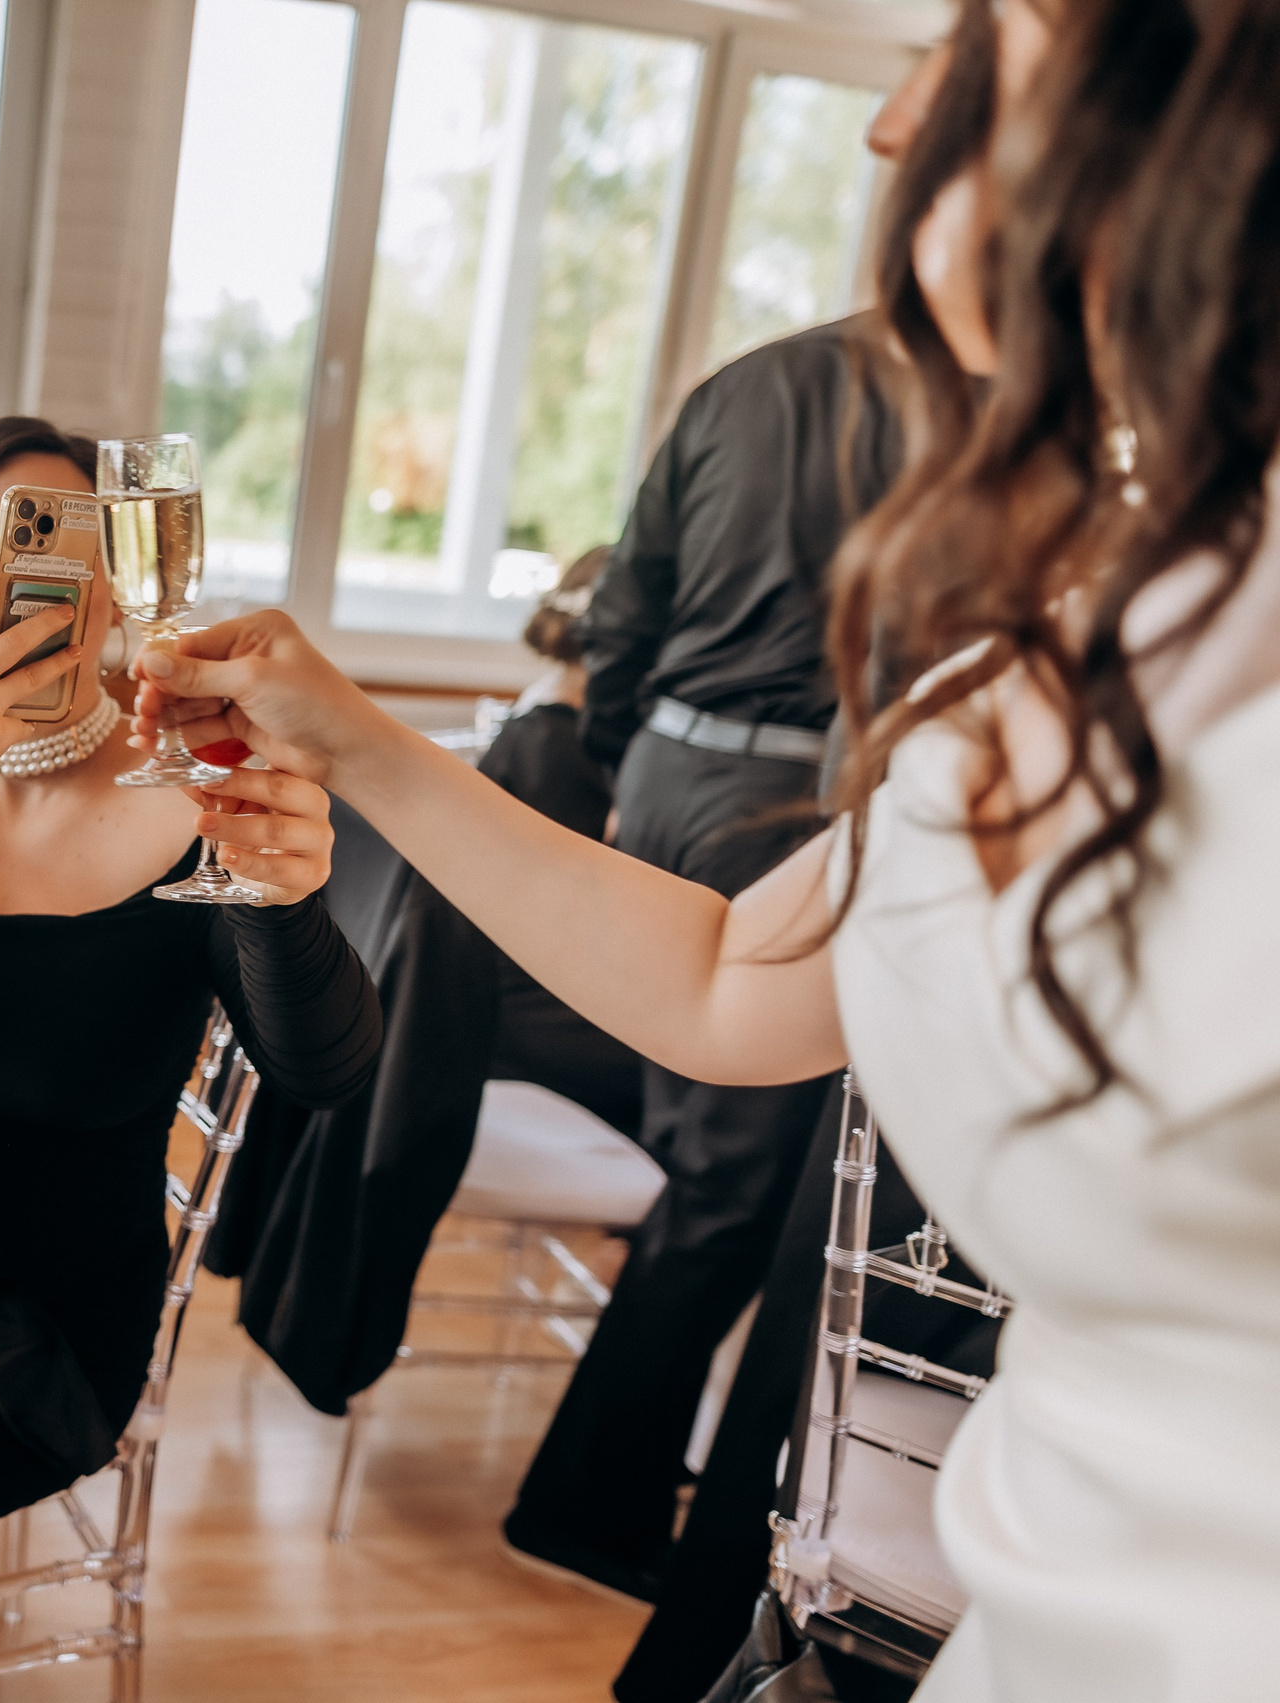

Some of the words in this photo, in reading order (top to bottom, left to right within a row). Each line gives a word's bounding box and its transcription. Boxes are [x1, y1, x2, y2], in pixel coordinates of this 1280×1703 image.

[63, 501, 68, 509] Я
[69, 502, 73, 510] В
[73, 502, 97, 513] РЕСУРСЕ
[62, 517, 68, 526] Я
[17, 554, 23, 562] Я
[24, 557, 53, 566] позволяю
[5, 565, 28, 573] полной
[29, 567, 68, 577] насыщенной
